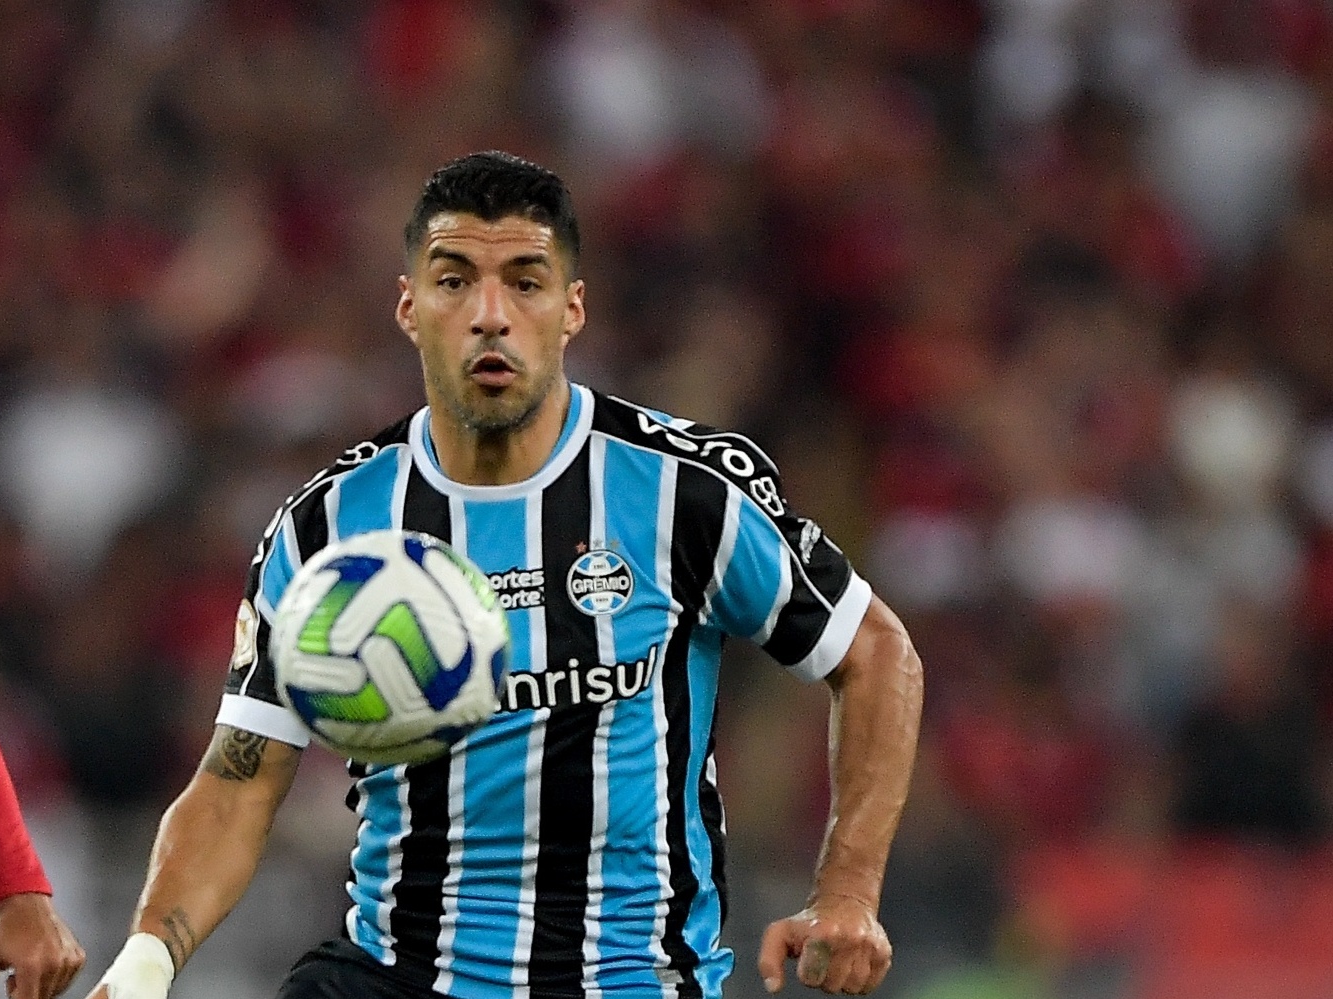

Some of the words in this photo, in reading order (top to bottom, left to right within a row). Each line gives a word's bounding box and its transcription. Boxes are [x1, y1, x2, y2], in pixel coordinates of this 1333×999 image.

[491, 570, 545, 590] ortes
[497, 591, 541, 609] orte
[496, 646, 658, 711] nrisul
